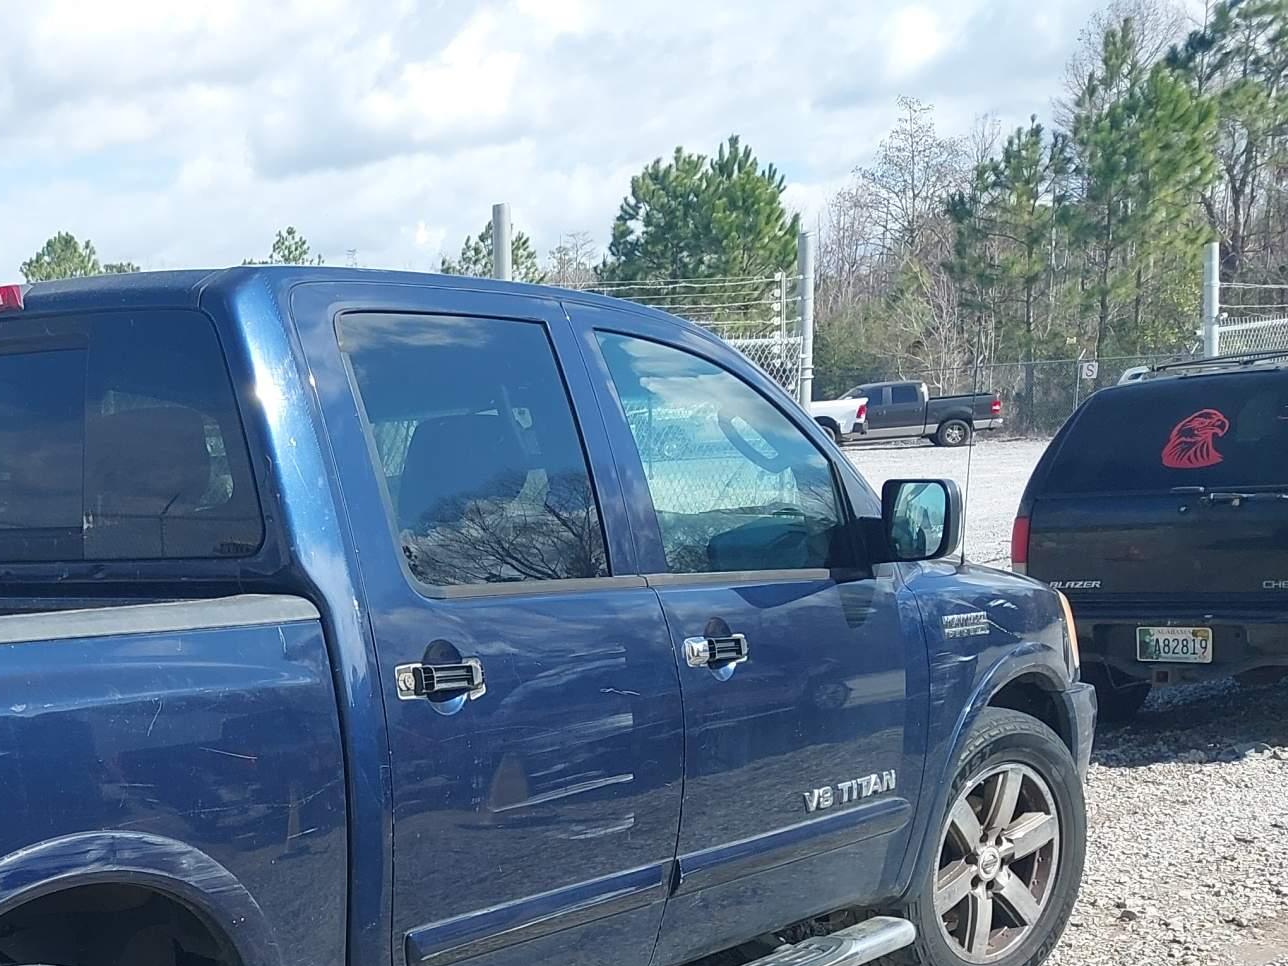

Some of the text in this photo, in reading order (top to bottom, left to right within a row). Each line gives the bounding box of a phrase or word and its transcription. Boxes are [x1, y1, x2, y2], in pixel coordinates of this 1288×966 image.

[1085, 363, 1095, 377] S
[1049, 580, 1102, 589] BLAZER
[1153, 638, 1209, 656] A82819
[802, 769, 896, 812] V8 TITAN
